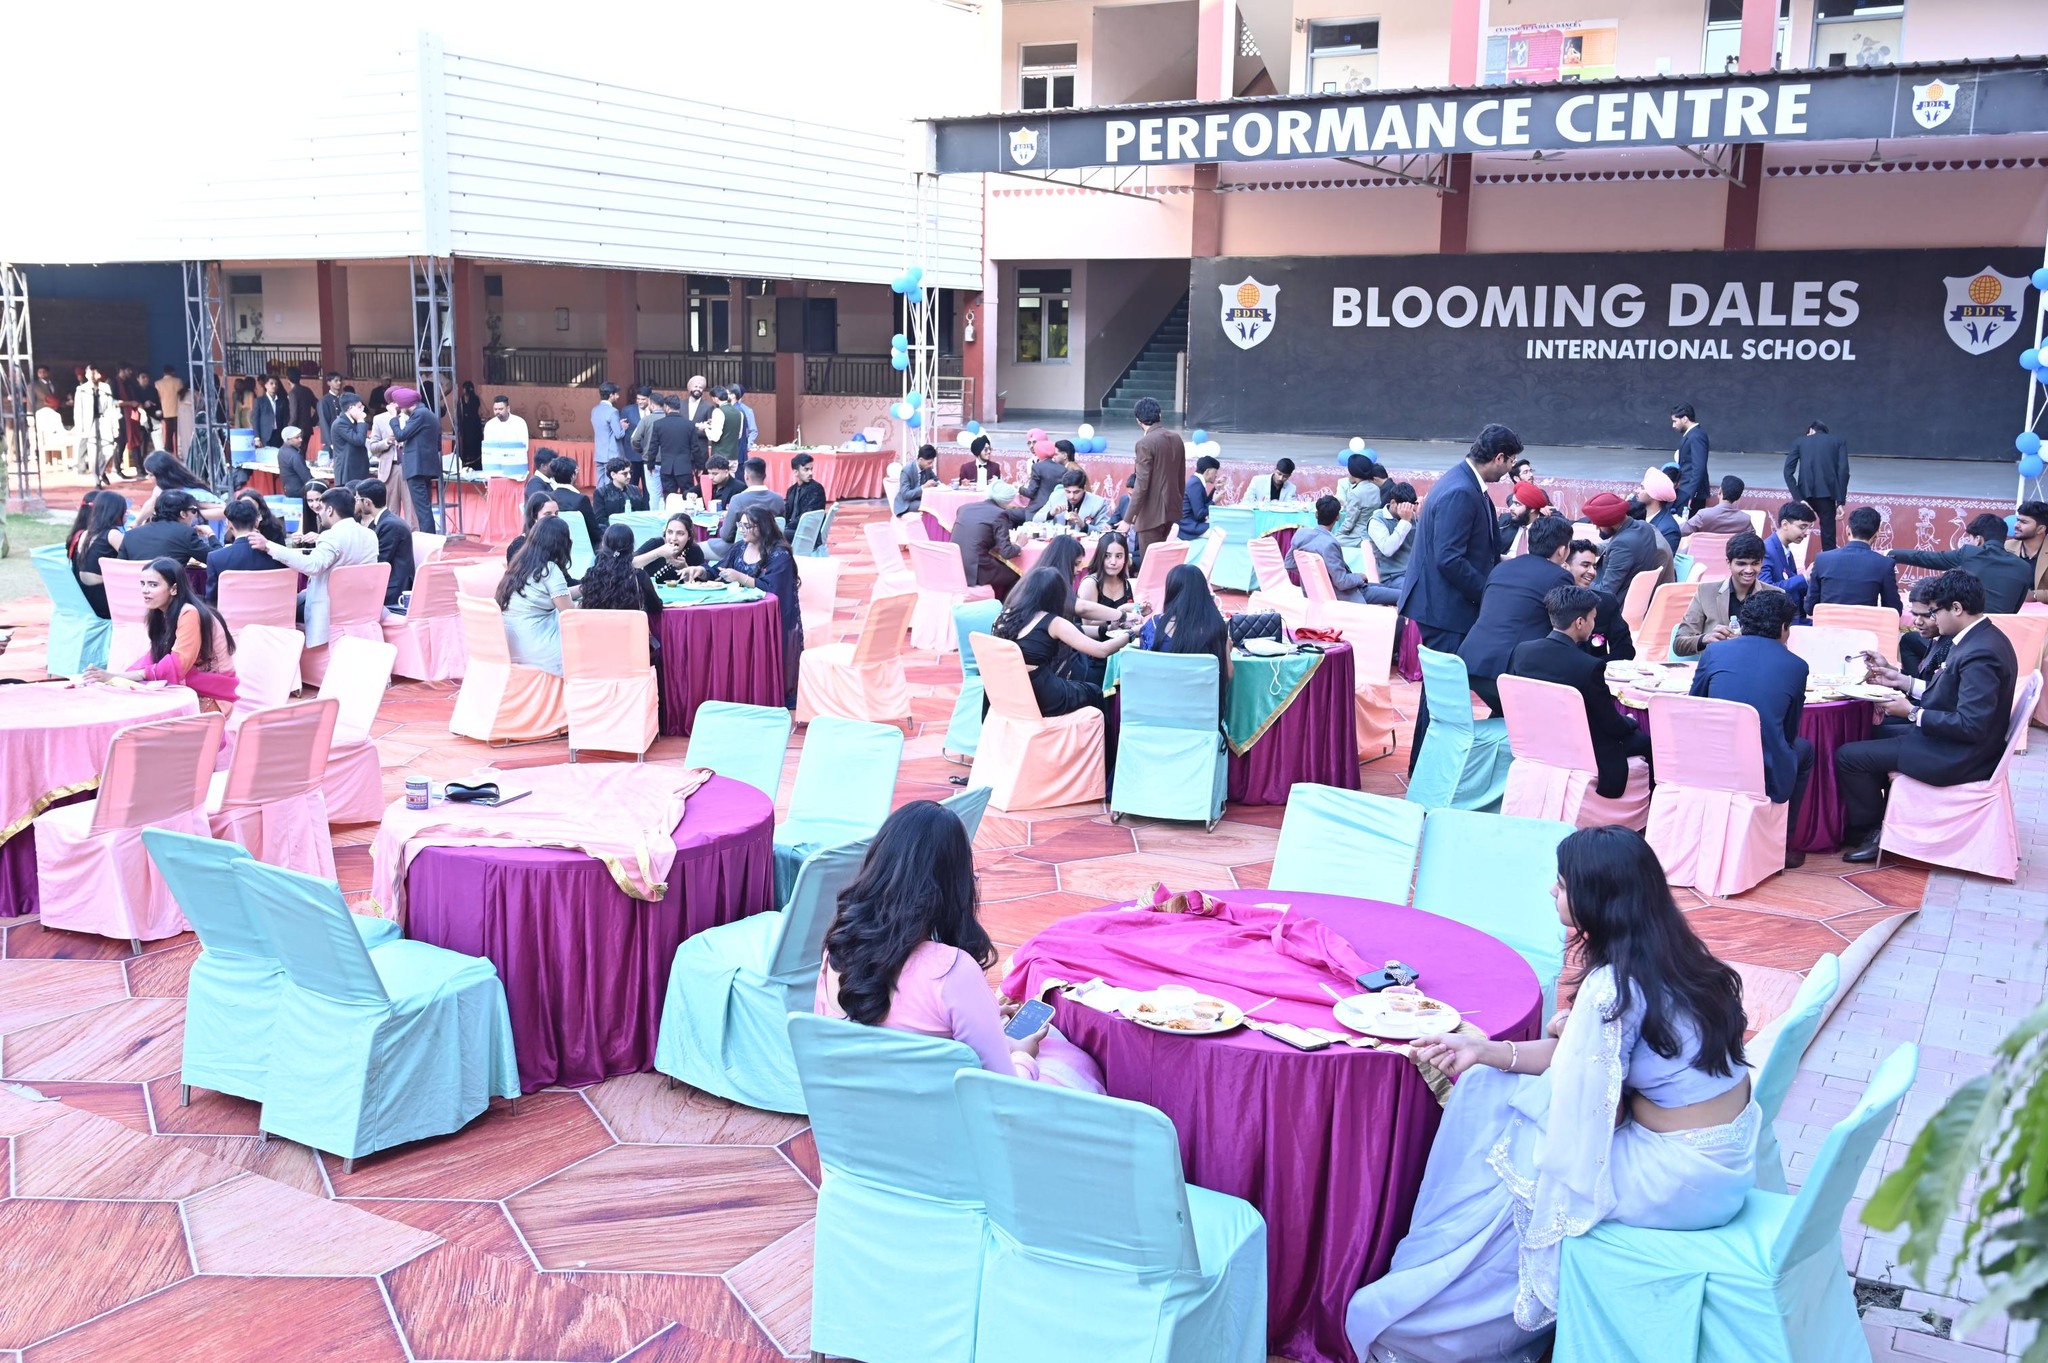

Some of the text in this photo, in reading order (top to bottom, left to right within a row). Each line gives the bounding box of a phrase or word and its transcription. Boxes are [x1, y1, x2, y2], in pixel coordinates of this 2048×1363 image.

[1530, 22, 1554, 31] INDIAN
[1105, 83, 1811, 163] PERFORMANCE CENTRE
[1332, 280, 1860, 329] BLOOMING DALES
[1962, 306, 2006, 317] BDIS
[1234, 309, 1264, 318] BDIS
[1526, 338, 1856, 362] INTERNATIONAL SCHOOL
